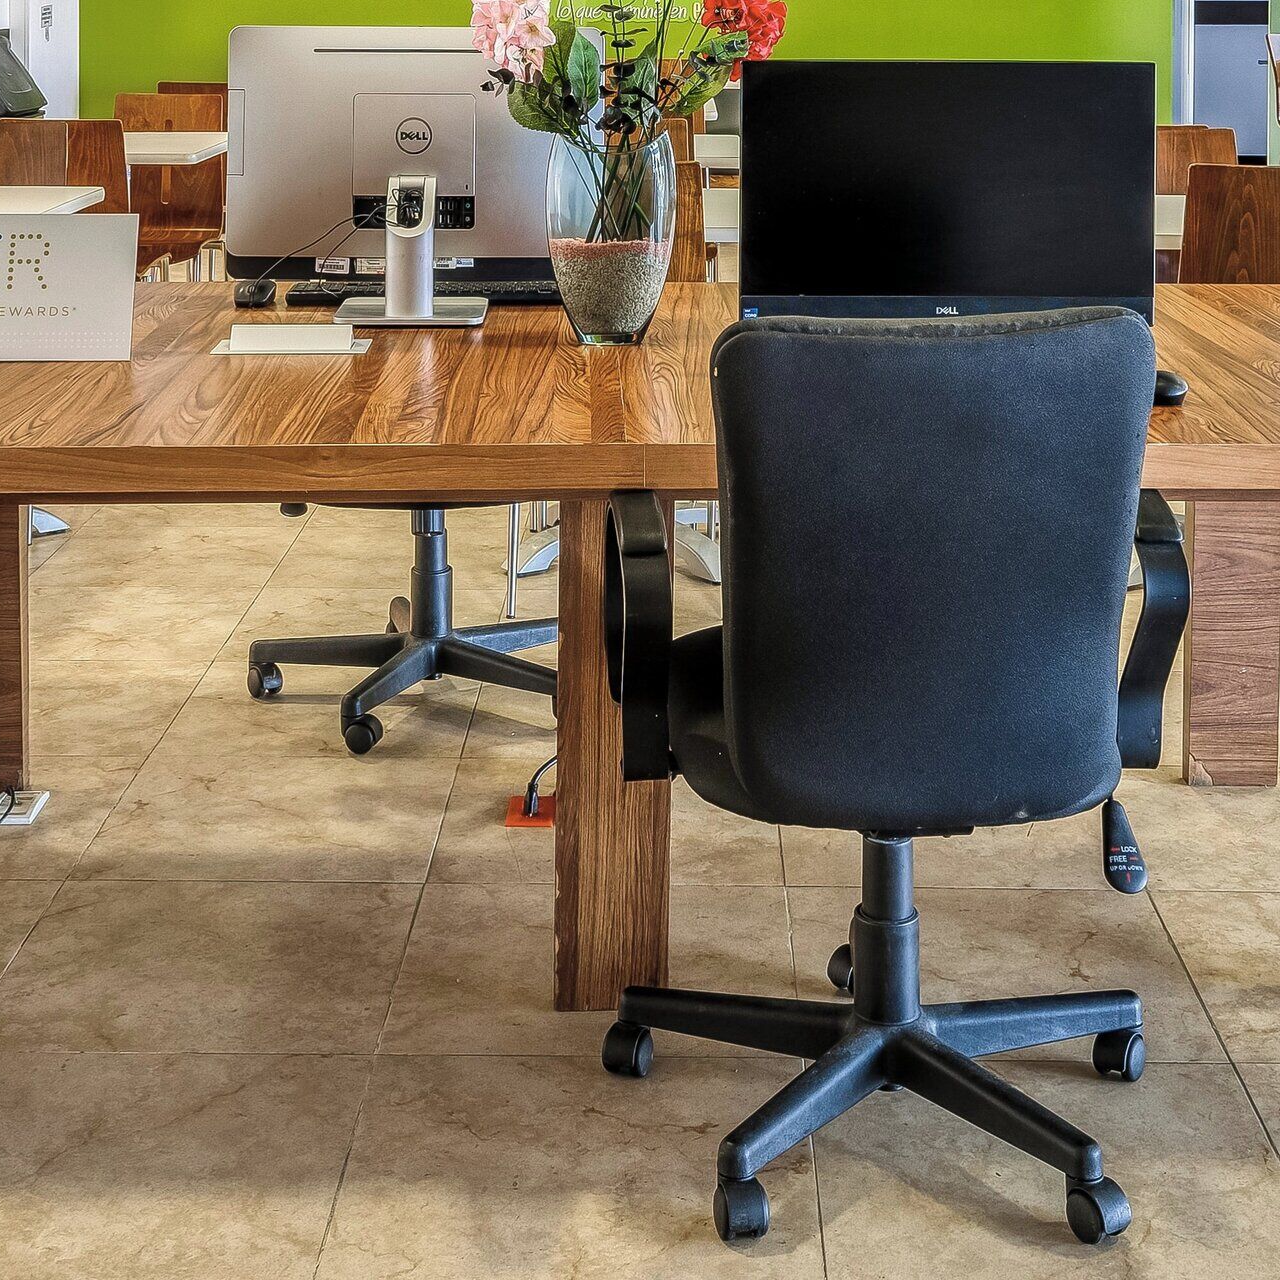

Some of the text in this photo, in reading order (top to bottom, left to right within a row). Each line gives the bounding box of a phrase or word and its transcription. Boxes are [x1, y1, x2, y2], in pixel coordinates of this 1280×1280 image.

[400, 131, 428, 140] DELL
[935, 306, 959, 315] DELL
[1120, 845, 1138, 853] LOCK
[1109, 855, 1128, 864] FREE
